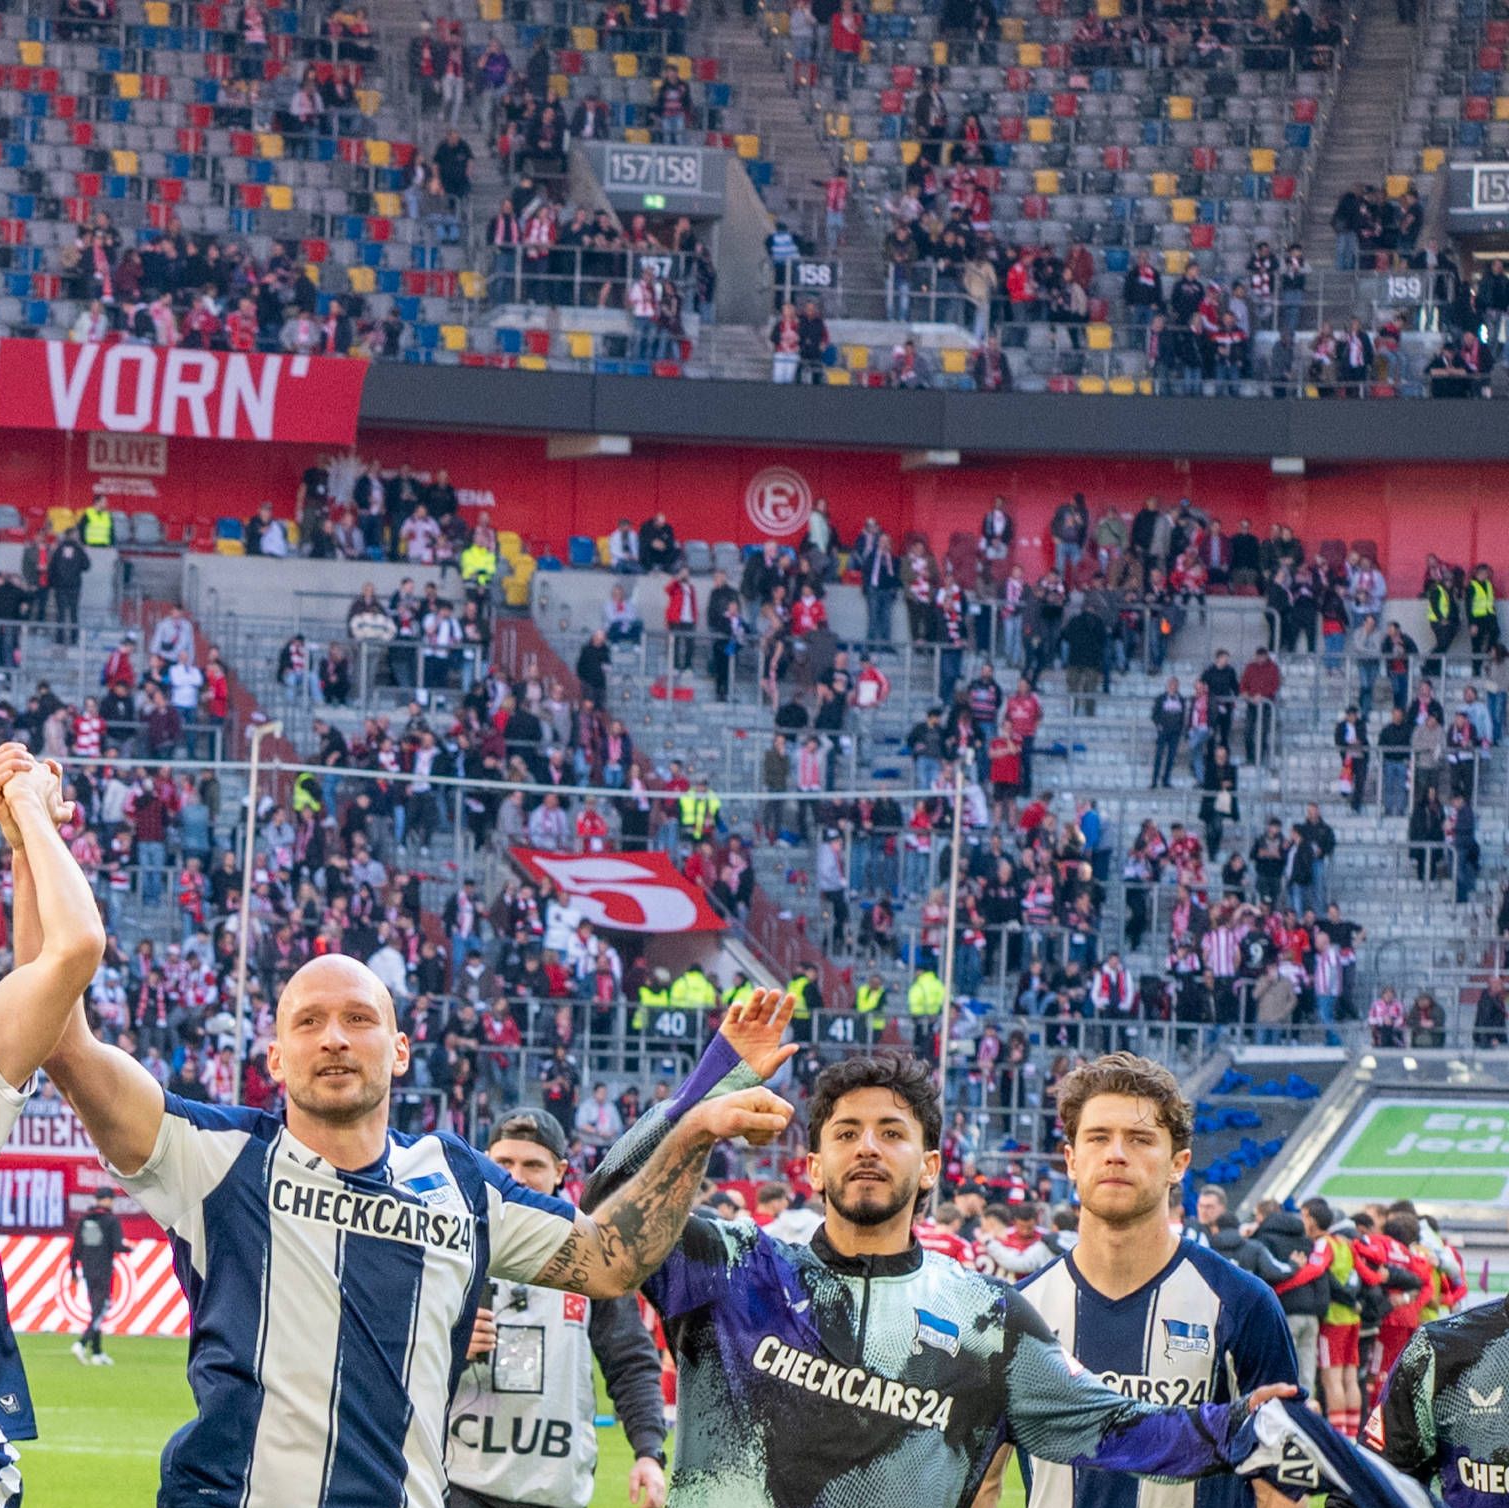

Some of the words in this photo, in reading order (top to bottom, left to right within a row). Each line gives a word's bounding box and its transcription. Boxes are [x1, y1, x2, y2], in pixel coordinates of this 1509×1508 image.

[612, 154, 650, 180] 157
[658, 156, 697, 184] 158
[1481, 172, 1509, 203] 15
[788, 264, 821, 285] 158
[1387, 276, 1421, 299] 159
[46, 338, 310, 441] VORN'
[656, 1011, 687, 1035] 40
[826, 1018, 855, 1041] 41
[1423, 1112, 1509, 1131] En
[1386, 1132, 1509, 1157] jed
[272, 1178, 473, 1254] CHECKCARS24
[753, 1335, 955, 1431] CHECKCARS24
[451, 1413, 574, 1459] CLUB
[1458, 1456, 1509, 1494] CHE
